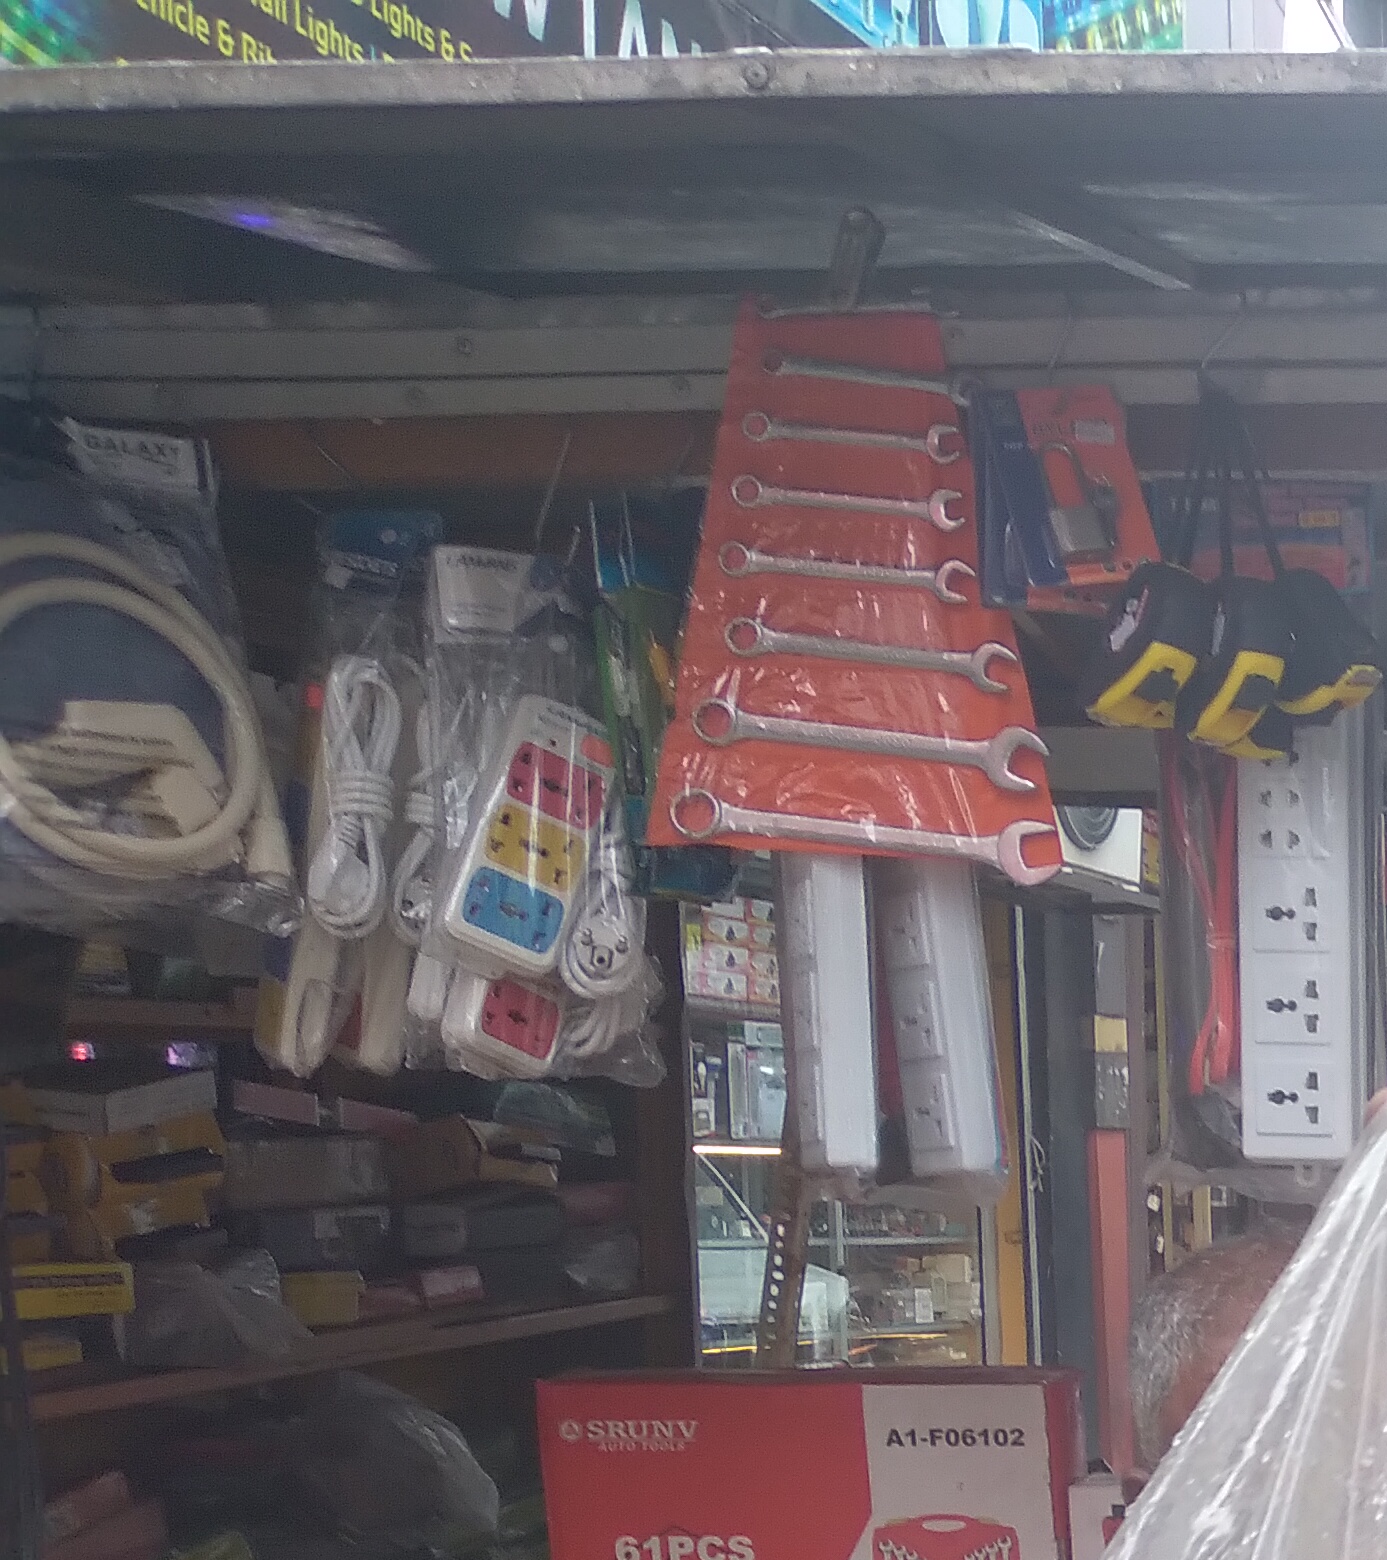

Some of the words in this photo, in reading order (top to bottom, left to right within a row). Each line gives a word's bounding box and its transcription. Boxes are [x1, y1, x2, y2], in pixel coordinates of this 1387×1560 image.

[295, 0, 365, 63] Lights
[586, 1420, 699, 1440] SRUNV
[886, 1428, 1026, 1447] A1-F06102
